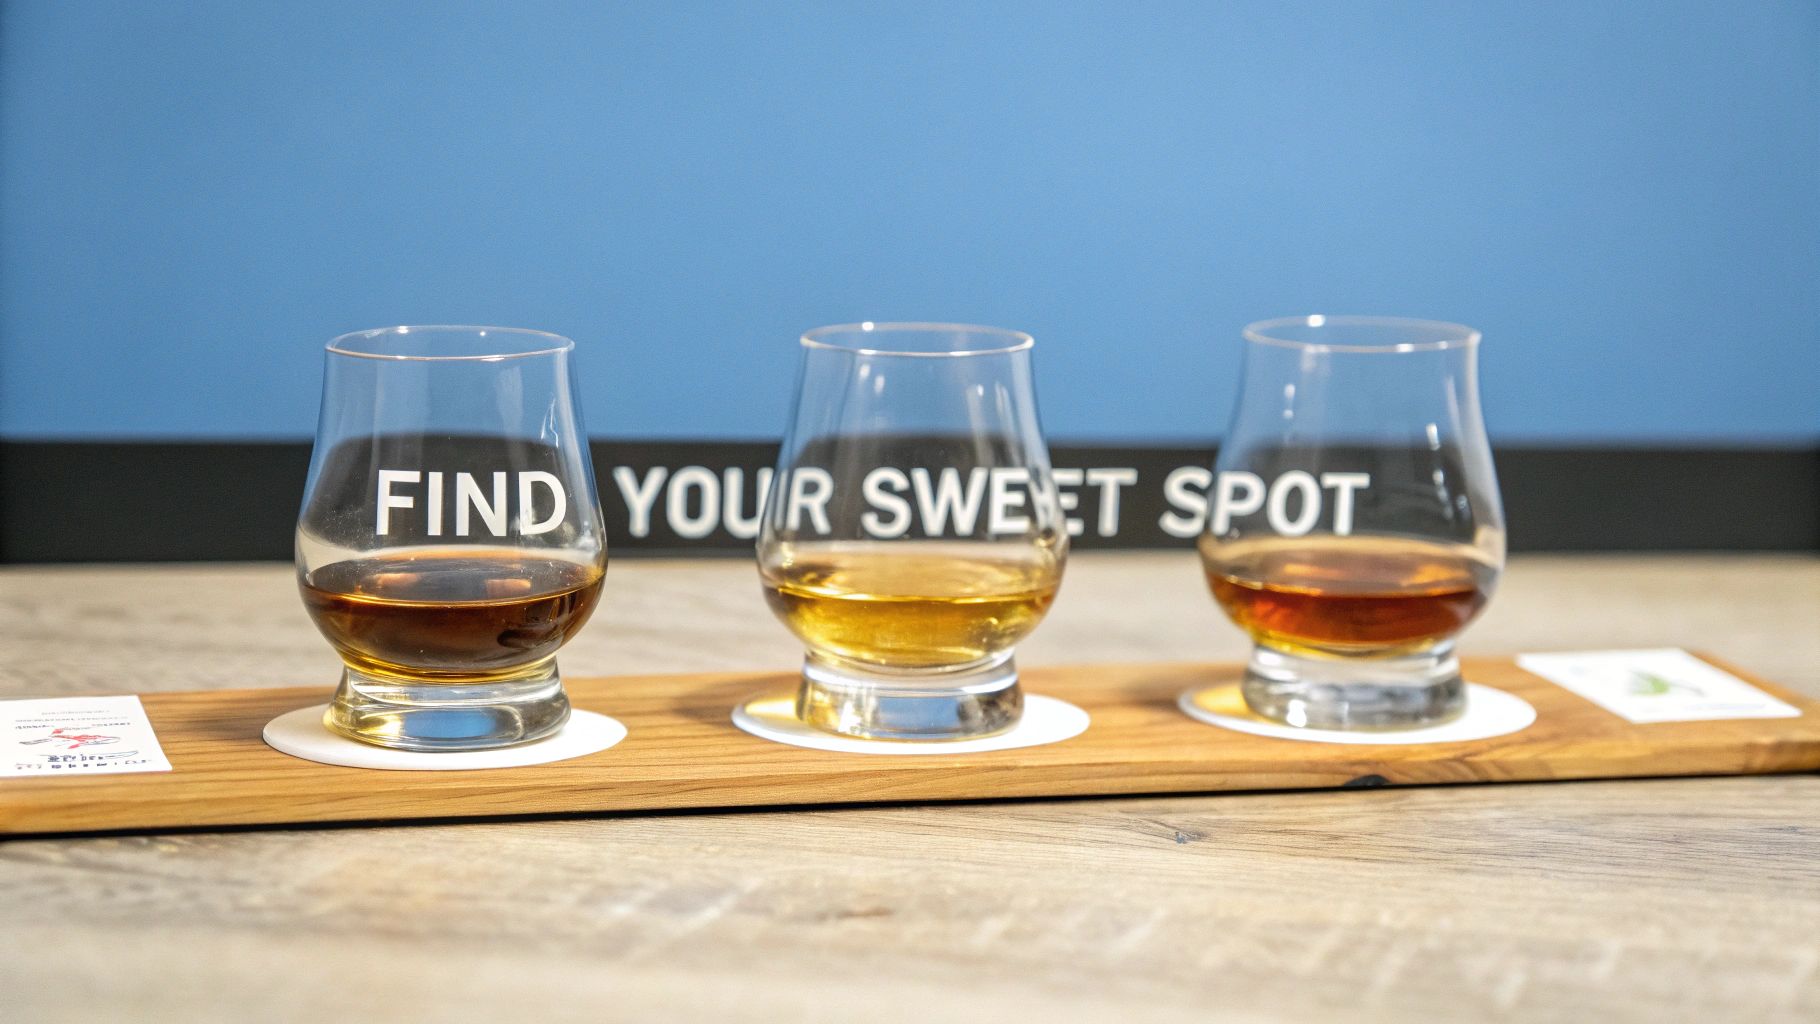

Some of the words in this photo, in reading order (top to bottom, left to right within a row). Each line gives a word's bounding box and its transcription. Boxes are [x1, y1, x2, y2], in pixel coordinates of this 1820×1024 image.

[376, 469, 567, 537] FIND
[613, 465, 834, 540] YOUR
[860, 466, 1139, 539] SWEET
[1158, 465, 1371, 538] SPOT
